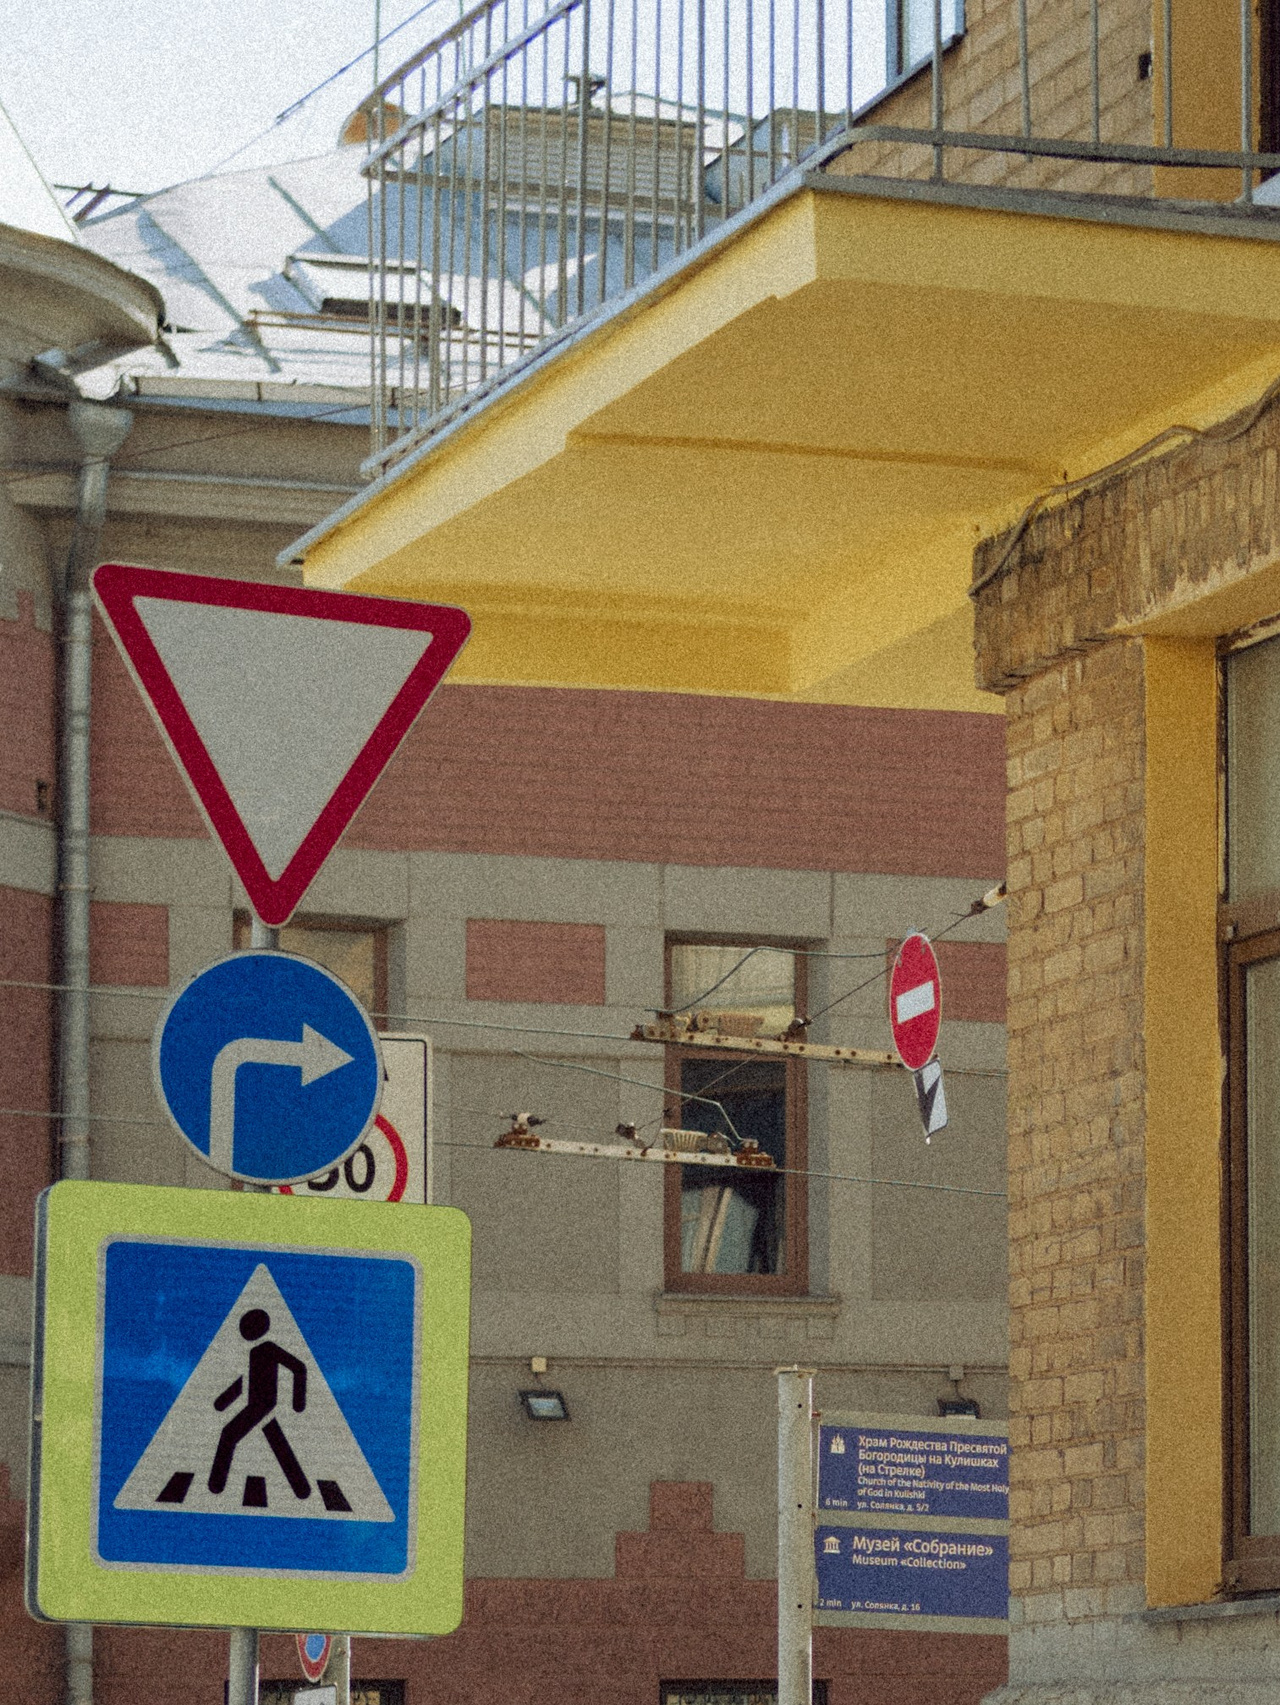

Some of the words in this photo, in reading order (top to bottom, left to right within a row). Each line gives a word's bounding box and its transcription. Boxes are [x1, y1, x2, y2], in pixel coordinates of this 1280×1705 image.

[859, 1435, 888, 1448] Храм
[890, 1437, 947, 1451] Рождества
[949, 1441, 1007, 1454] Пресвятой
[859, 1449, 927, 1464] Богородицы
[929, 1455, 942, 1464] на
[944, 1454, 999, 1468] Кулишках
[858, 1462, 876, 1475] (на
[877, 1463, 926, 1479] Стрелке)
[857, 1487, 867, 1496] of
[867, 1488, 884, 1497] God
[884, 1488, 893, 1497] in
[858, 1476, 886, 1486] Church
[887, 1478, 897, 1487] of
[897, 1478, 911, 1487] the
[912, 1480, 945, 1491] Nativity
[945, 1481, 955, 1490] of
[955, 1482, 970, 1491] the
[970, 1483, 991, 1492] Most
[991, 1484, 1010, 1495] Holy
[832, 1498, 848, 1507] min
[857, 1501, 869, 1510] ул.
[852, 1535, 900, 1554] Музей
[903, 1539, 994, 1558] «Собрание»
[852, 1554, 898, 1566] Museum
[900, 1557, 967, 1569] «Collection»
[826, 1599, 842, 1608] min
[851, 1601, 864, 1610] ул.
[911, 1603, 921, 1611] 16
